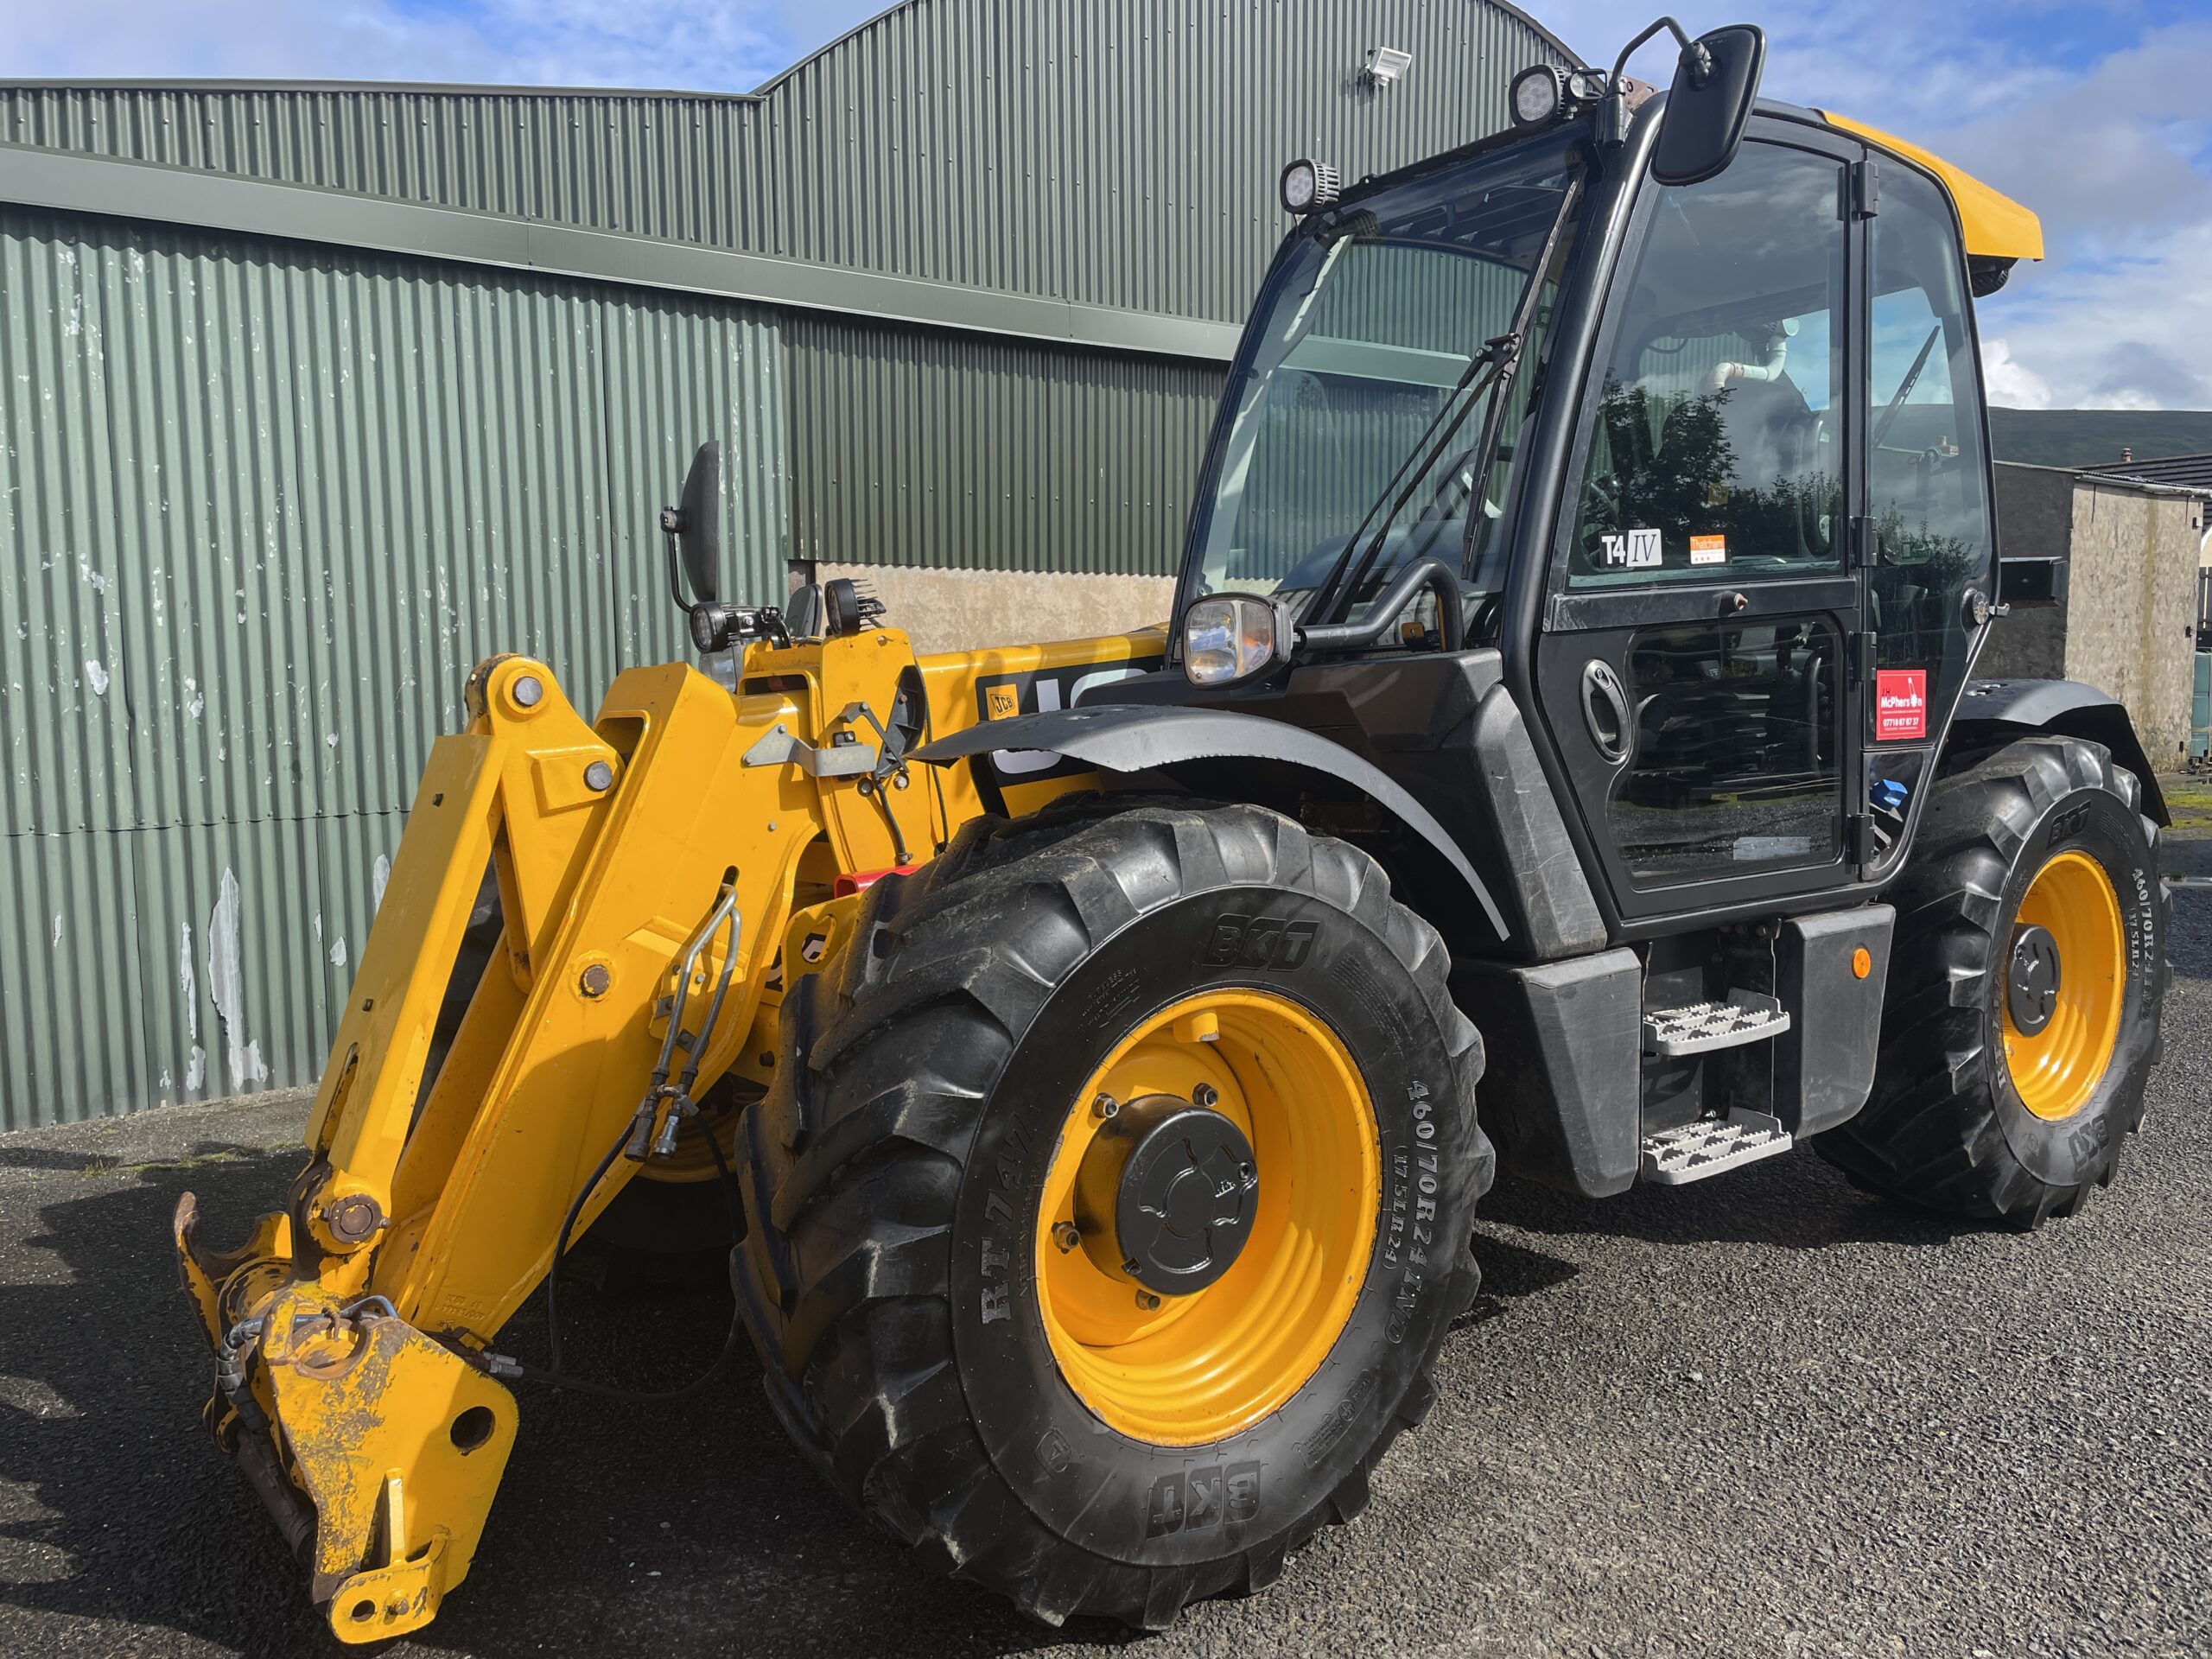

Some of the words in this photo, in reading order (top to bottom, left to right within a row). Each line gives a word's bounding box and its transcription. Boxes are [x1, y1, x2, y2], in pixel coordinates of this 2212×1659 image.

[1601, 535, 1626, 565] T4
[1632, 534, 1657, 563] IV
[1691, 538, 1724, 550] Thatcham
[995, 695, 1014, 713] JCB
[1205, 919, 1318, 967] BKT
[984, 1112, 1034, 1222] 747
[1406, 1080, 1440, 1268] 460/70R24
[980, 1236, 1012, 1325] RT
[1383, 1267, 1421, 1344] IND
[1149, 1467, 1259, 1534] BKT
